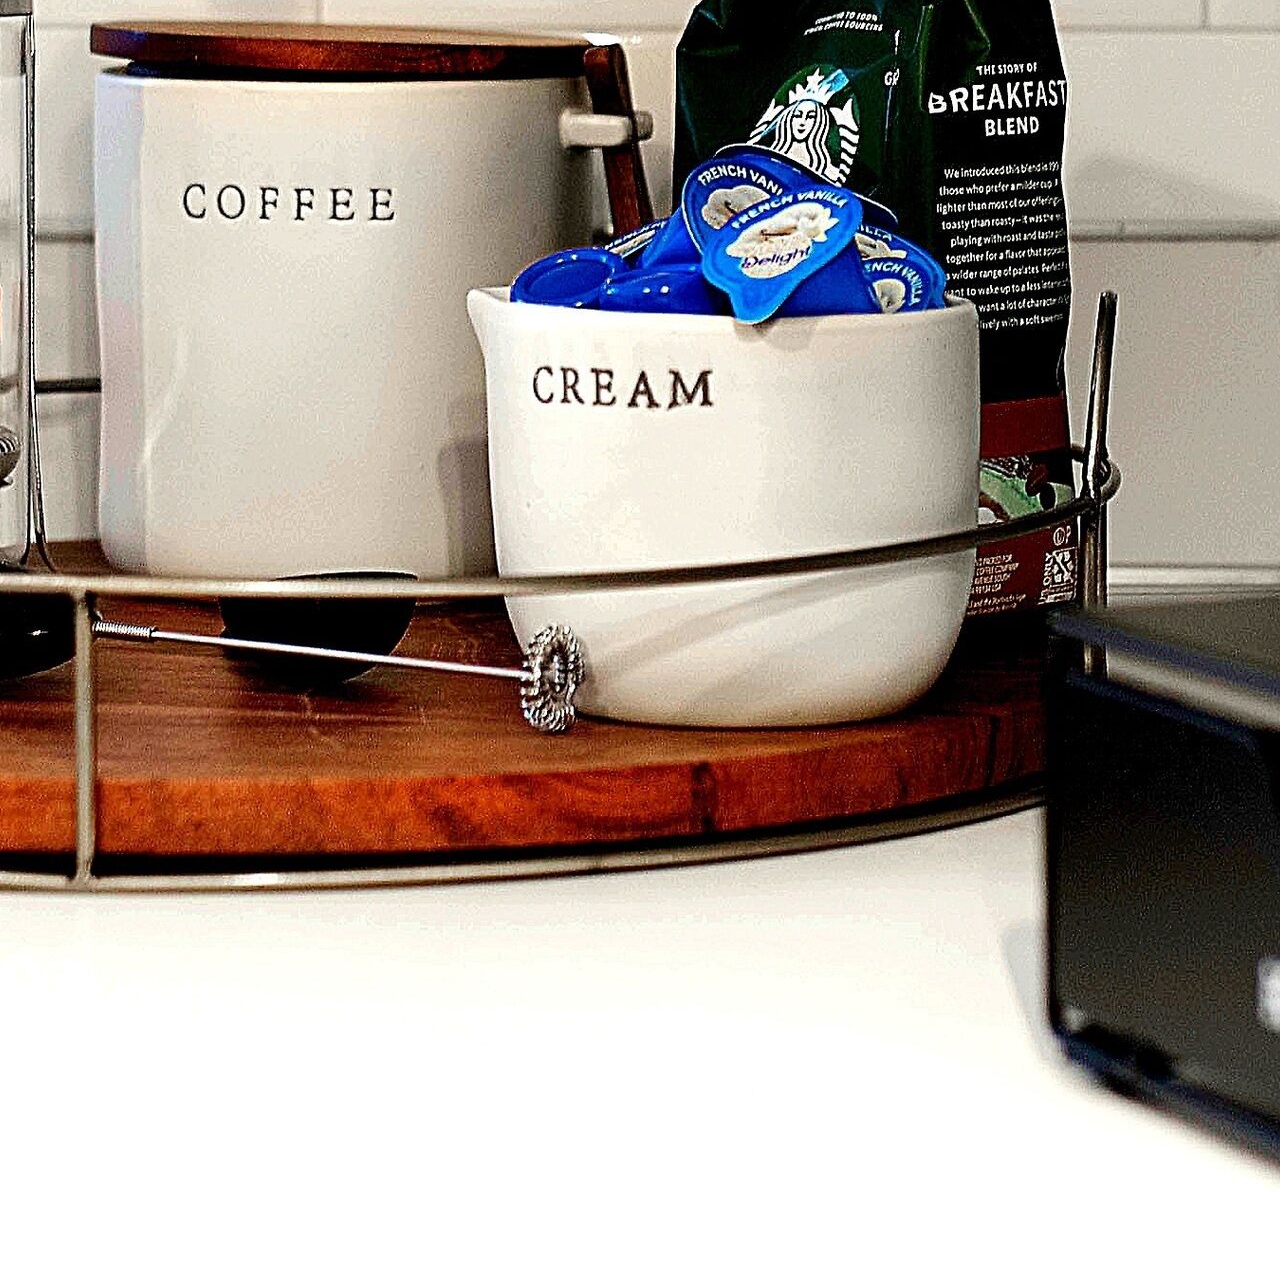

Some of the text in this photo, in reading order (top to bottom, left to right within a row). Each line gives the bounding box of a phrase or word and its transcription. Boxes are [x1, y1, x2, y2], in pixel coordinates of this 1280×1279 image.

[976, 62, 1038, 76] THE STORY OF
[927, 79, 1067, 114] BREAKFAST
[984, 115, 1040, 137] BLEND
[697, 164, 783, 196] FRENCH VANI
[943, 168, 960, 180] We
[960, 165, 1006, 178] introduced
[939, 185, 965, 197] those
[965, 183, 985, 195] who
[985, 181, 1010, 195] prefer
[182, 182, 397, 221] COFFEE
[936, 202, 966, 216] lighter
[967, 200, 987, 212] than
[988, 199, 1009, 211] most
[731, 193, 794, 230] FRENCH
[941, 218, 970, 232] toasty
[970, 217, 991, 229] than
[950, 235, 983, 249] playing
[983, 233, 1003, 245] with
[742, 245, 811, 270] Delight
[946, 251, 985, 265] together
[985, 250, 997, 262] for
[1027, 247, 1042, 258] that
[951, 269, 978, 281] wider
[979, 268, 1002, 280] range
[1002, 265, 1012, 276] of
[966, 287, 977, 297] to
[1000, 285, 1011, 295] up
[1011, 283, 1020, 293] to
[1026, 280, 1041, 291] less
[978, 302, 1000, 313] want
[1006, 299, 1017, 310] lot
[1017, 298, 1027, 309] of
[532, 365, 715, 410] CREAM
